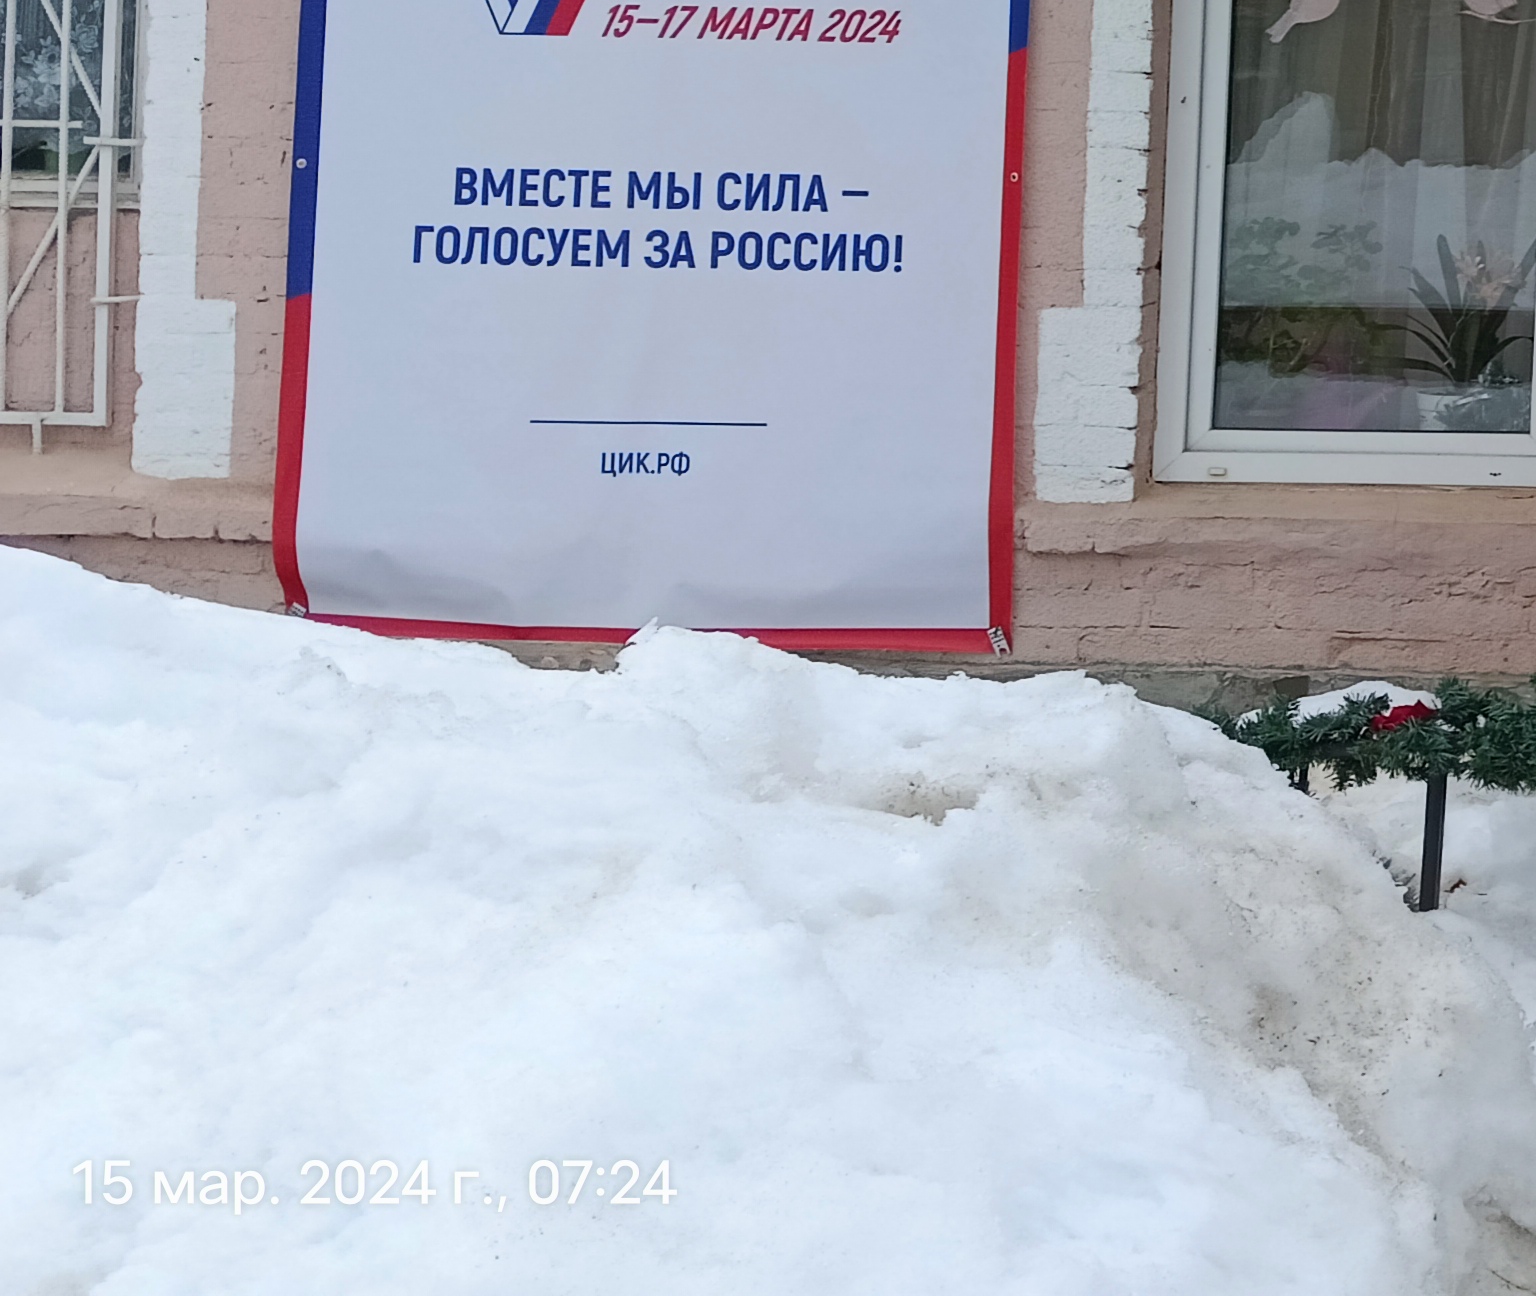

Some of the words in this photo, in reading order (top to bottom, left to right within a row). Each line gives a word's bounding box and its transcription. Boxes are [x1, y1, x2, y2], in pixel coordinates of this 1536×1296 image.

[696, 6, 814, 42] МАРТА
[817, 8, 902, 44] 2024
[453, 167, 612, 209] ВМЕСТЕ
[626, 170, 702, 211] МЫ
[716, 172, 829, 213] СИЛА
[412, 225, 631, 269] ГОЛОСУЕМ
[643, 230, 697, 270] ЗА
[710, 230, 904, 273] РОССИЮ!
[600, 451, 691, 478] ЦИК.РФ
